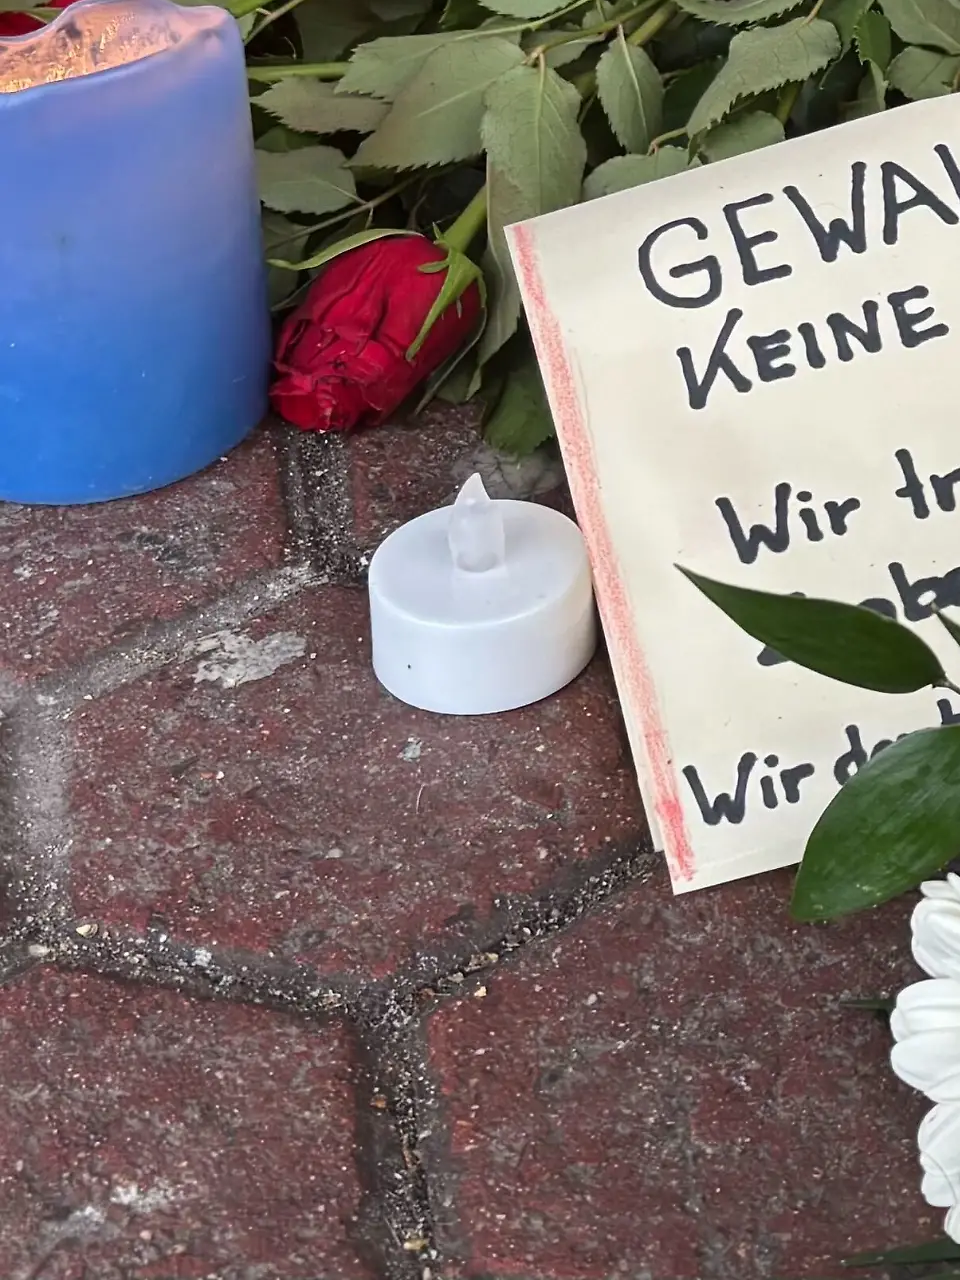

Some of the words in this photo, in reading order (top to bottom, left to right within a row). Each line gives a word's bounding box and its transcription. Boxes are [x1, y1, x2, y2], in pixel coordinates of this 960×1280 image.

[677, 285, 949, 409] KEINE
[715, 482, 860, 564] Wir
[682, 751, 815, 826] Wir
